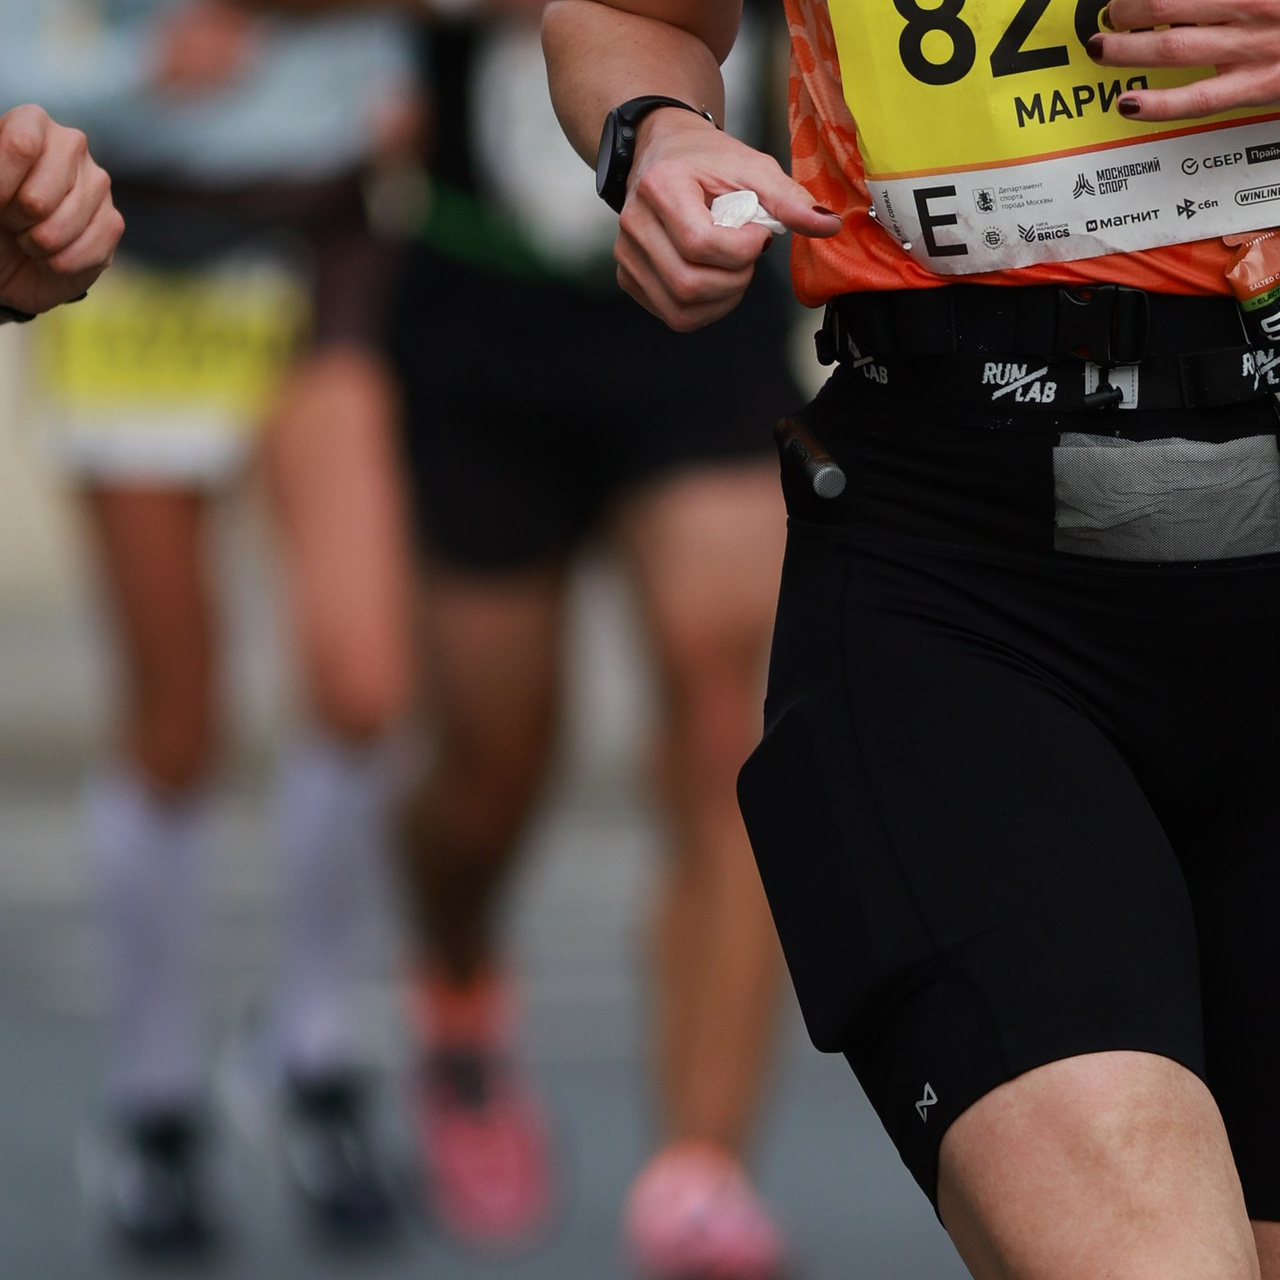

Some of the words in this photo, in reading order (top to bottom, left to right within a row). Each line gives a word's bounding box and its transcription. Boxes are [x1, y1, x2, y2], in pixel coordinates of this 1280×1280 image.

[1202, 152, 1243, 169] СБЕР
[1096, 157, 1161, 183] МОСКОВСКИЙ
[999, 182, 1042, 195] Департамент
[1099, 178, 1128, 195] СПОРТ
[882, 189, 895, 218] CORRAL
[1000, 194, 1023, 202] спорта
[1002, 202, 1025, 210] города
[1026, 198, 1053, 206] Москвы
[1198, 200, 1218, 210] сбп
[1037, 228, 1070, 241] BRICS
[1249, 276, 1274, 291] SALTED
[1242, 348, 1275, 377] RN
[982, 362, 1028, 385] RUN
[1015, 381, 1057, 403] LAB
